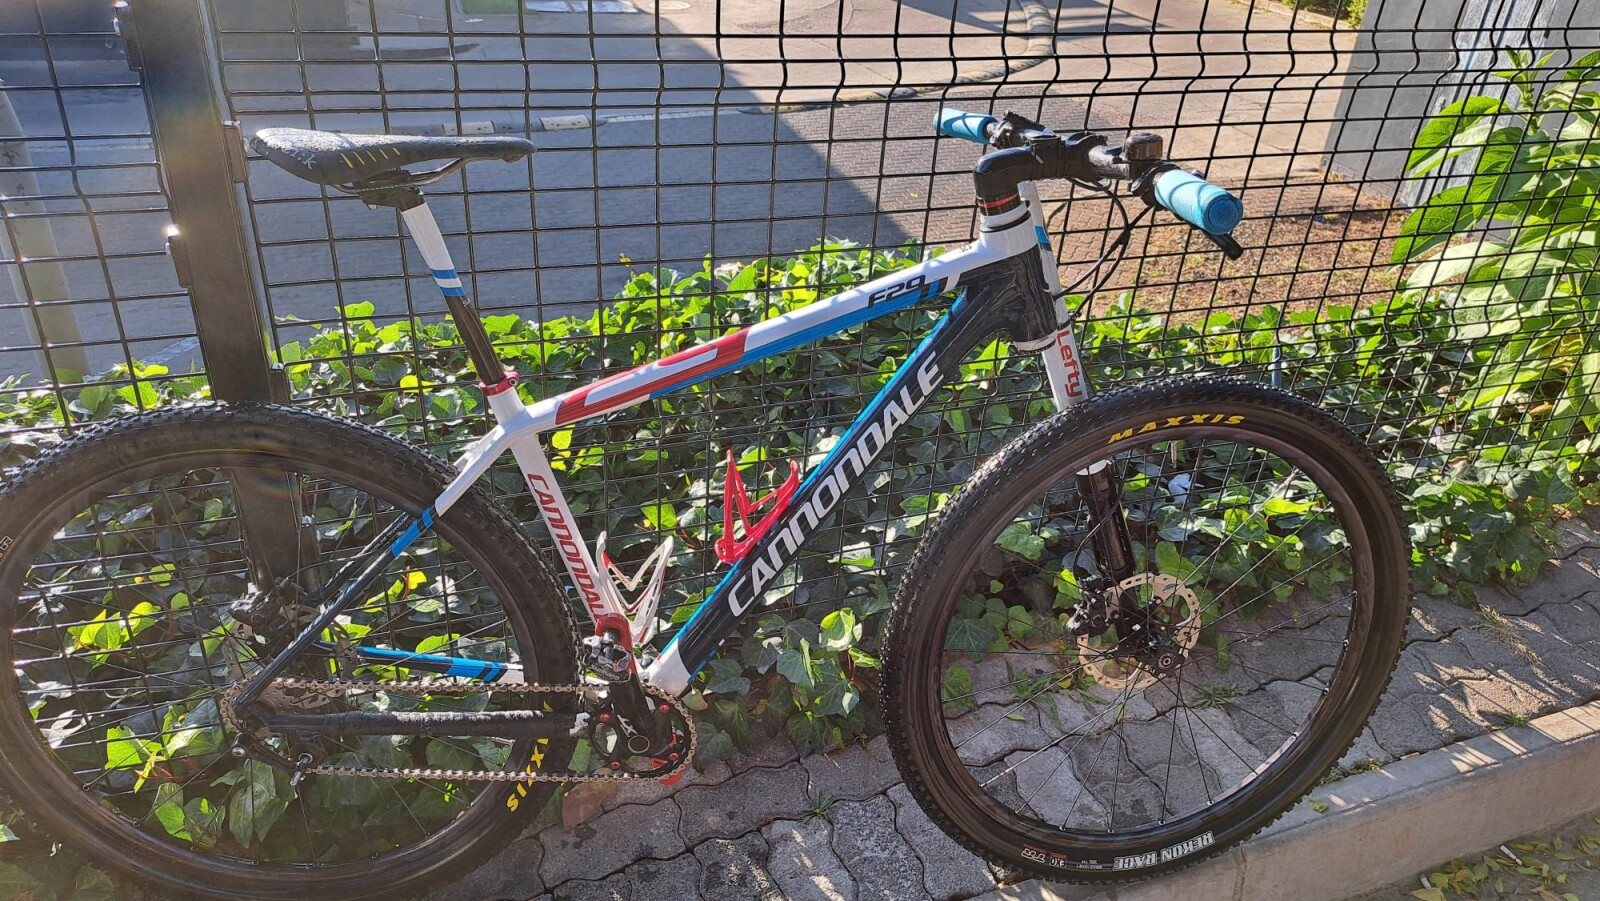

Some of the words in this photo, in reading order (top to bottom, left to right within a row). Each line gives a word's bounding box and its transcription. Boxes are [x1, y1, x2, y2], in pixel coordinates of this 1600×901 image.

[868, 275, 927, 309] F29
[1056, 330, 1082, 398] Lefty
[1106, 414, 1245, 445] MAXXIS
[728, 350, 944, 617] CANNONDALE
[528, 473, 605, 622] CANNONDAL
[1113, 851, 1157, 871] RACE
[1160, 831, 1215, 863] REKON
